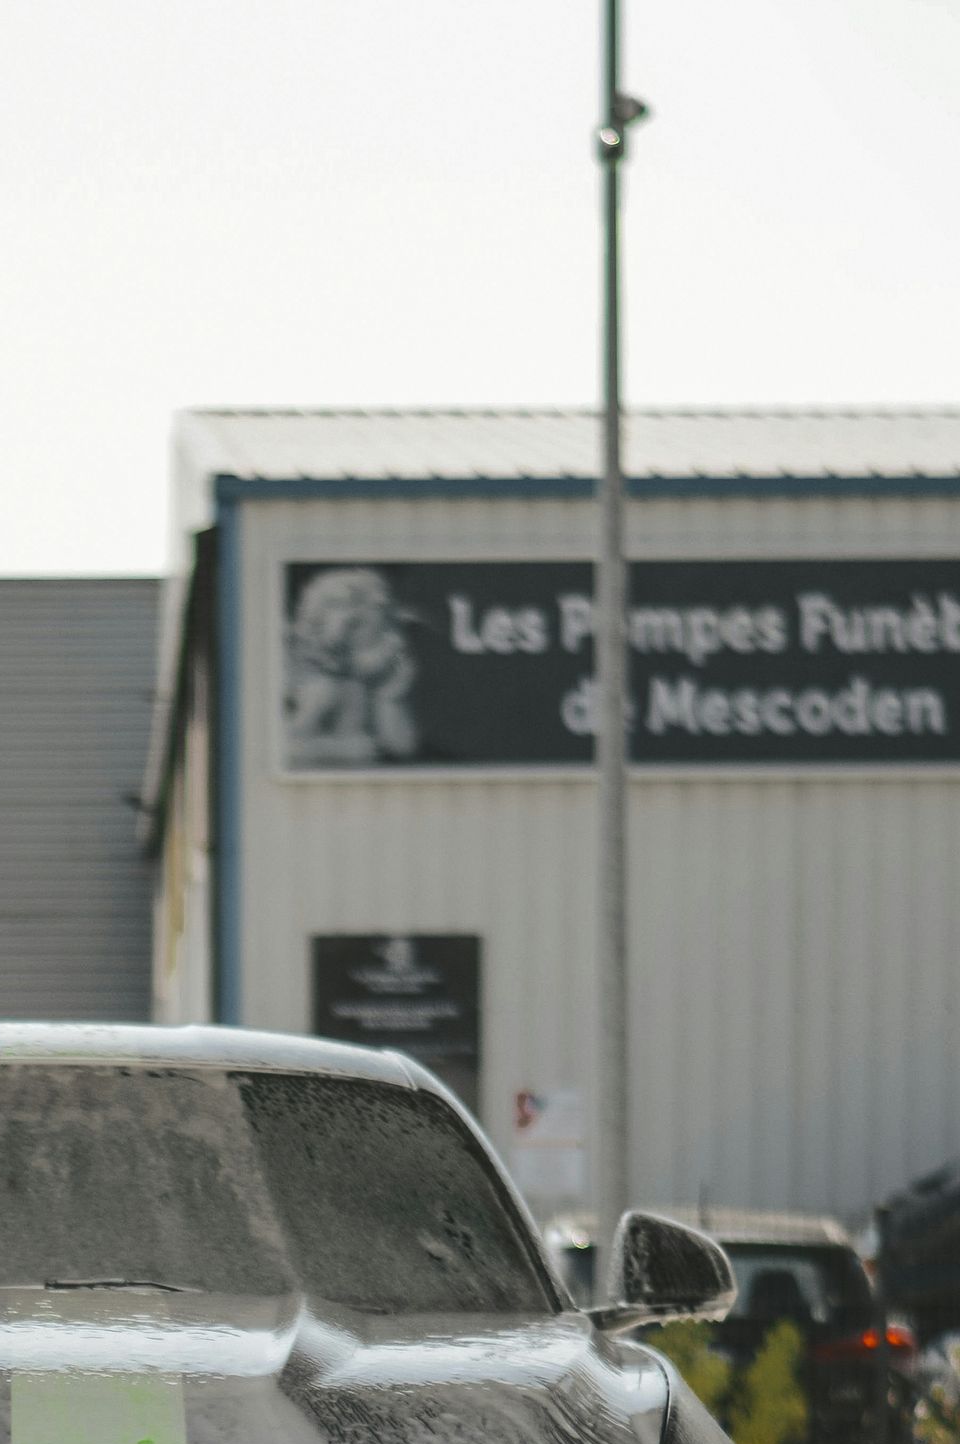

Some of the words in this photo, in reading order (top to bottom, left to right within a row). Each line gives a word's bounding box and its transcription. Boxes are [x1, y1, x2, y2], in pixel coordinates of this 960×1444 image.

[448, 594, 547, 653] Les
[556, 594, 786, 667] Pmpes
[559, 677, 636, 735] d
[646, 675, 945, 735] Mescoden
